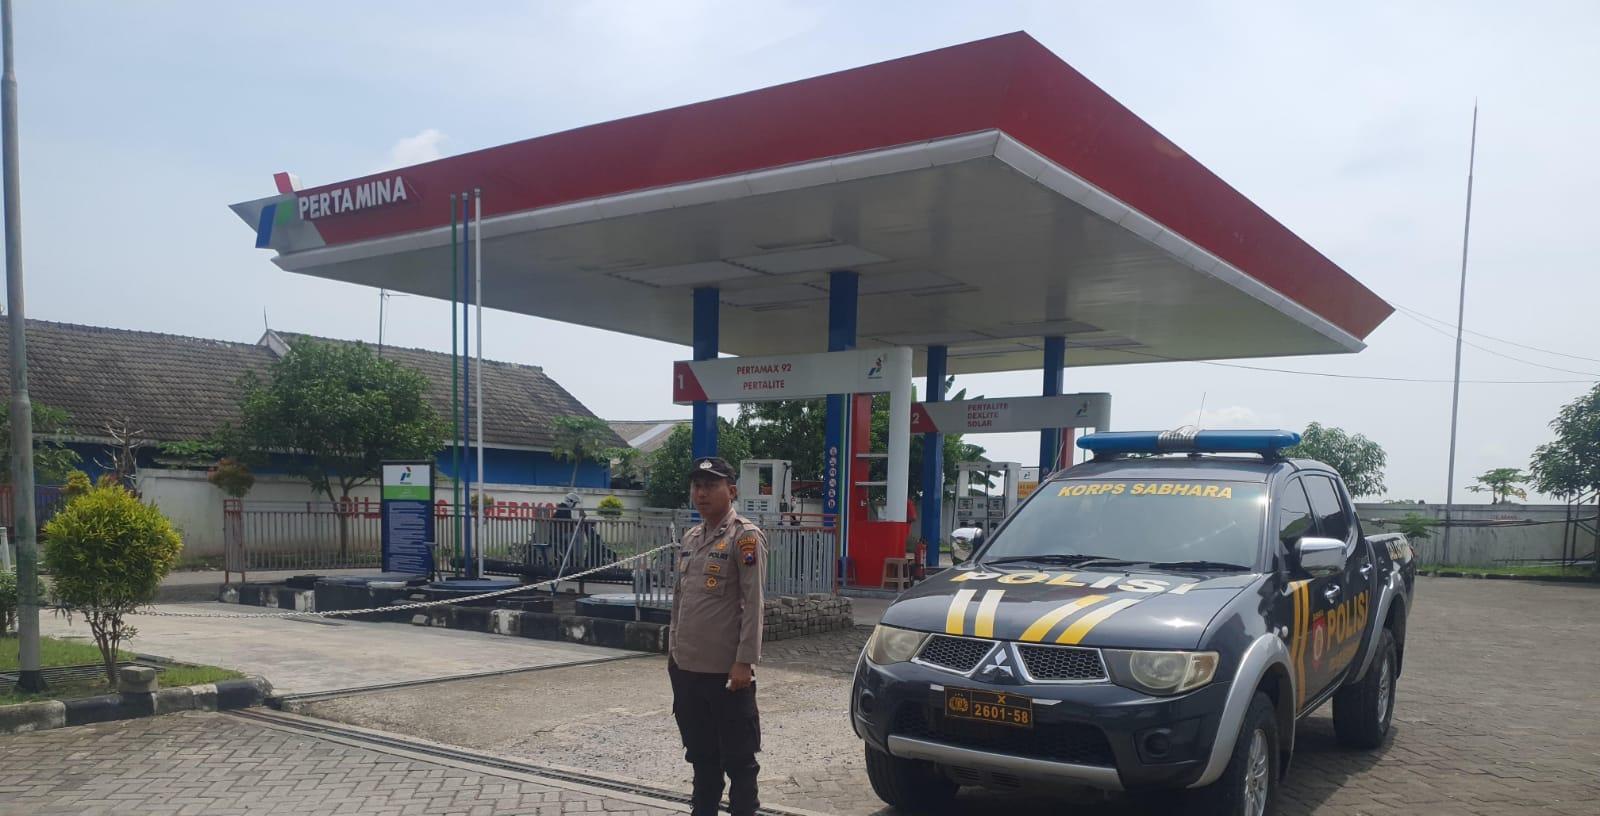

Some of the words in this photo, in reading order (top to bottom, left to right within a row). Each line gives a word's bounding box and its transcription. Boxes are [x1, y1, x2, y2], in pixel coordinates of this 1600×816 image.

[299, 175, 408, 220] PERTAMINA
[736, 364, 780, 375] PERTAMAX
[781, 363, 792, 373] 92
[677, 373, 685, 390] 1
[743, 379, 785, 391] PERTALITE
[967, 402, 1009, 412] PERTALITE
[912, 412, 920, 424] 2
[967, 420, 992, 428] SOLAR
[1057, 483, 1126, 497] KORPS
[1130, 483, 1233, 499] SABHARA
[950, 571, 1200, 595] POLISI
[1327, 589, 1369, 653] POLISI
[974, 703, 1029, 724] 2601-58
